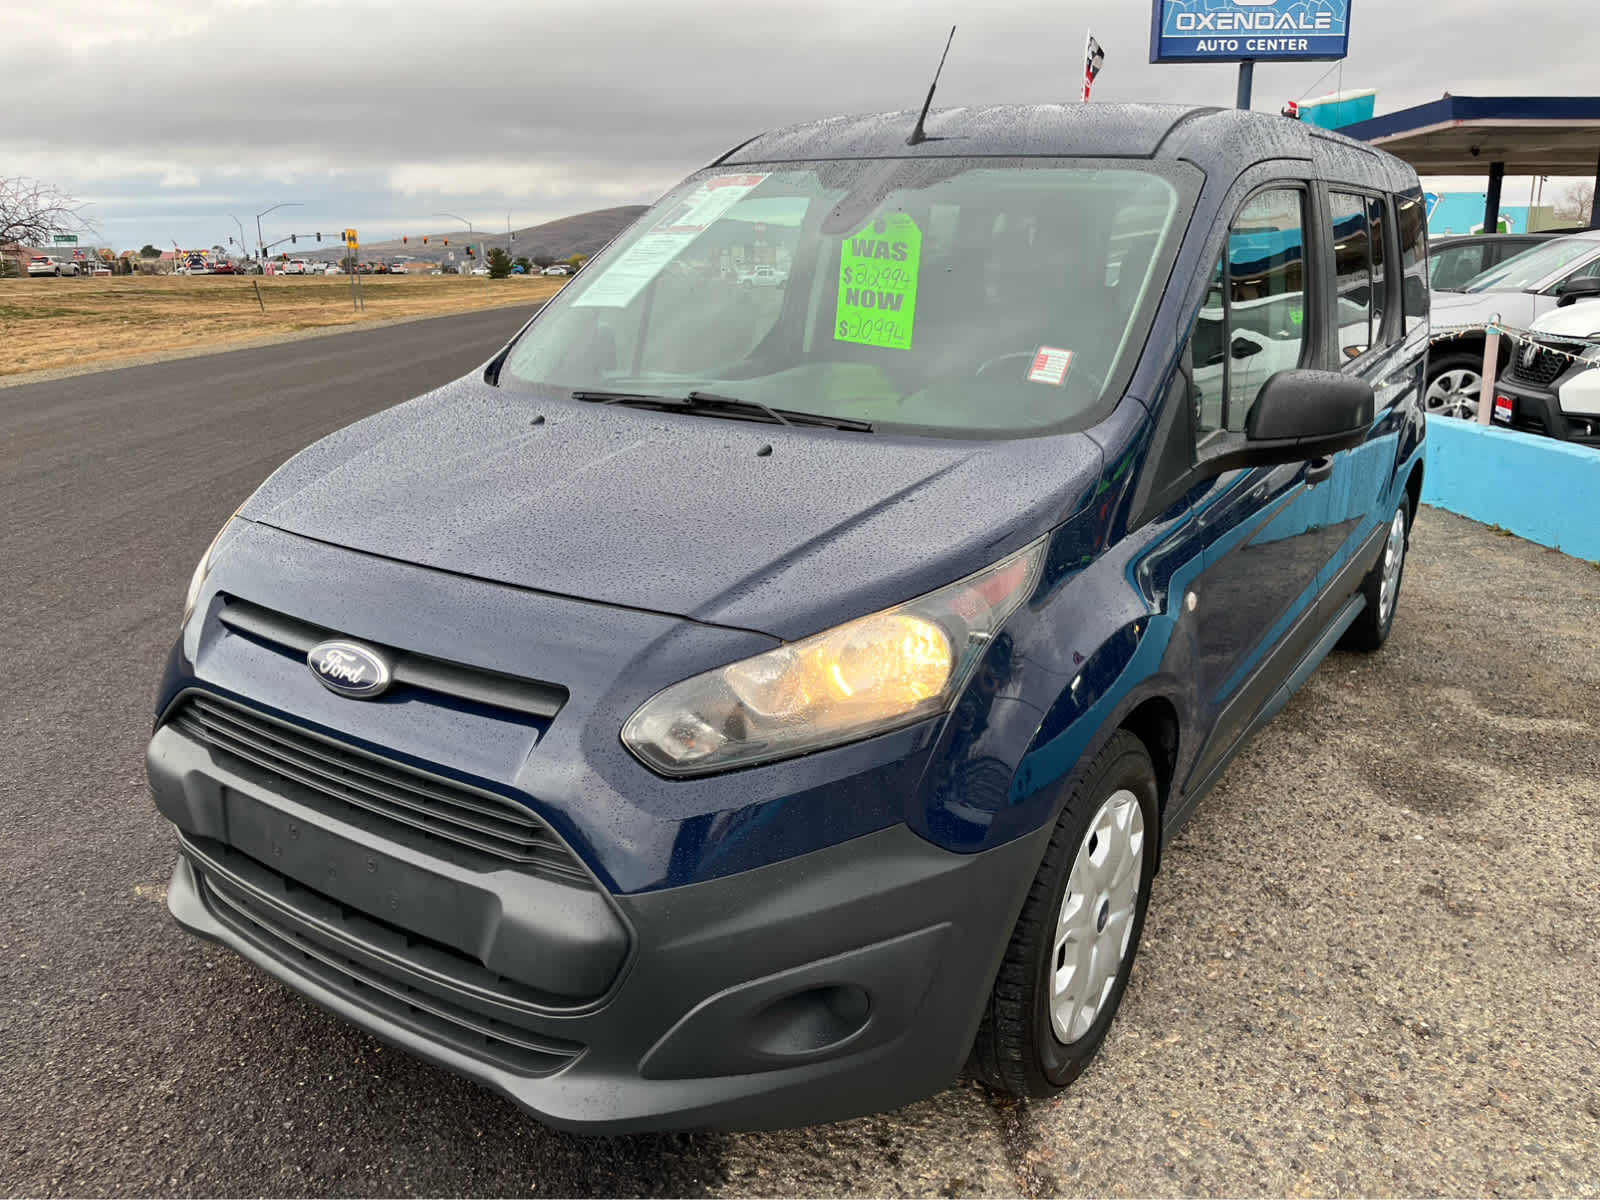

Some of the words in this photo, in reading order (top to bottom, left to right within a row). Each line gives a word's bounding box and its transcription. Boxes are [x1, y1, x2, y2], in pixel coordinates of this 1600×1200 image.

[1176, 12, 1332, 31] OXENDALE
[1196, 39, 1239, 52] AUTO
[1246, 38, 1308, 51] CENTER
[851, 238, 908, 262] WAS
[845, 288, 905, 312] NOW
[319, 649, 366, 684] Ford
